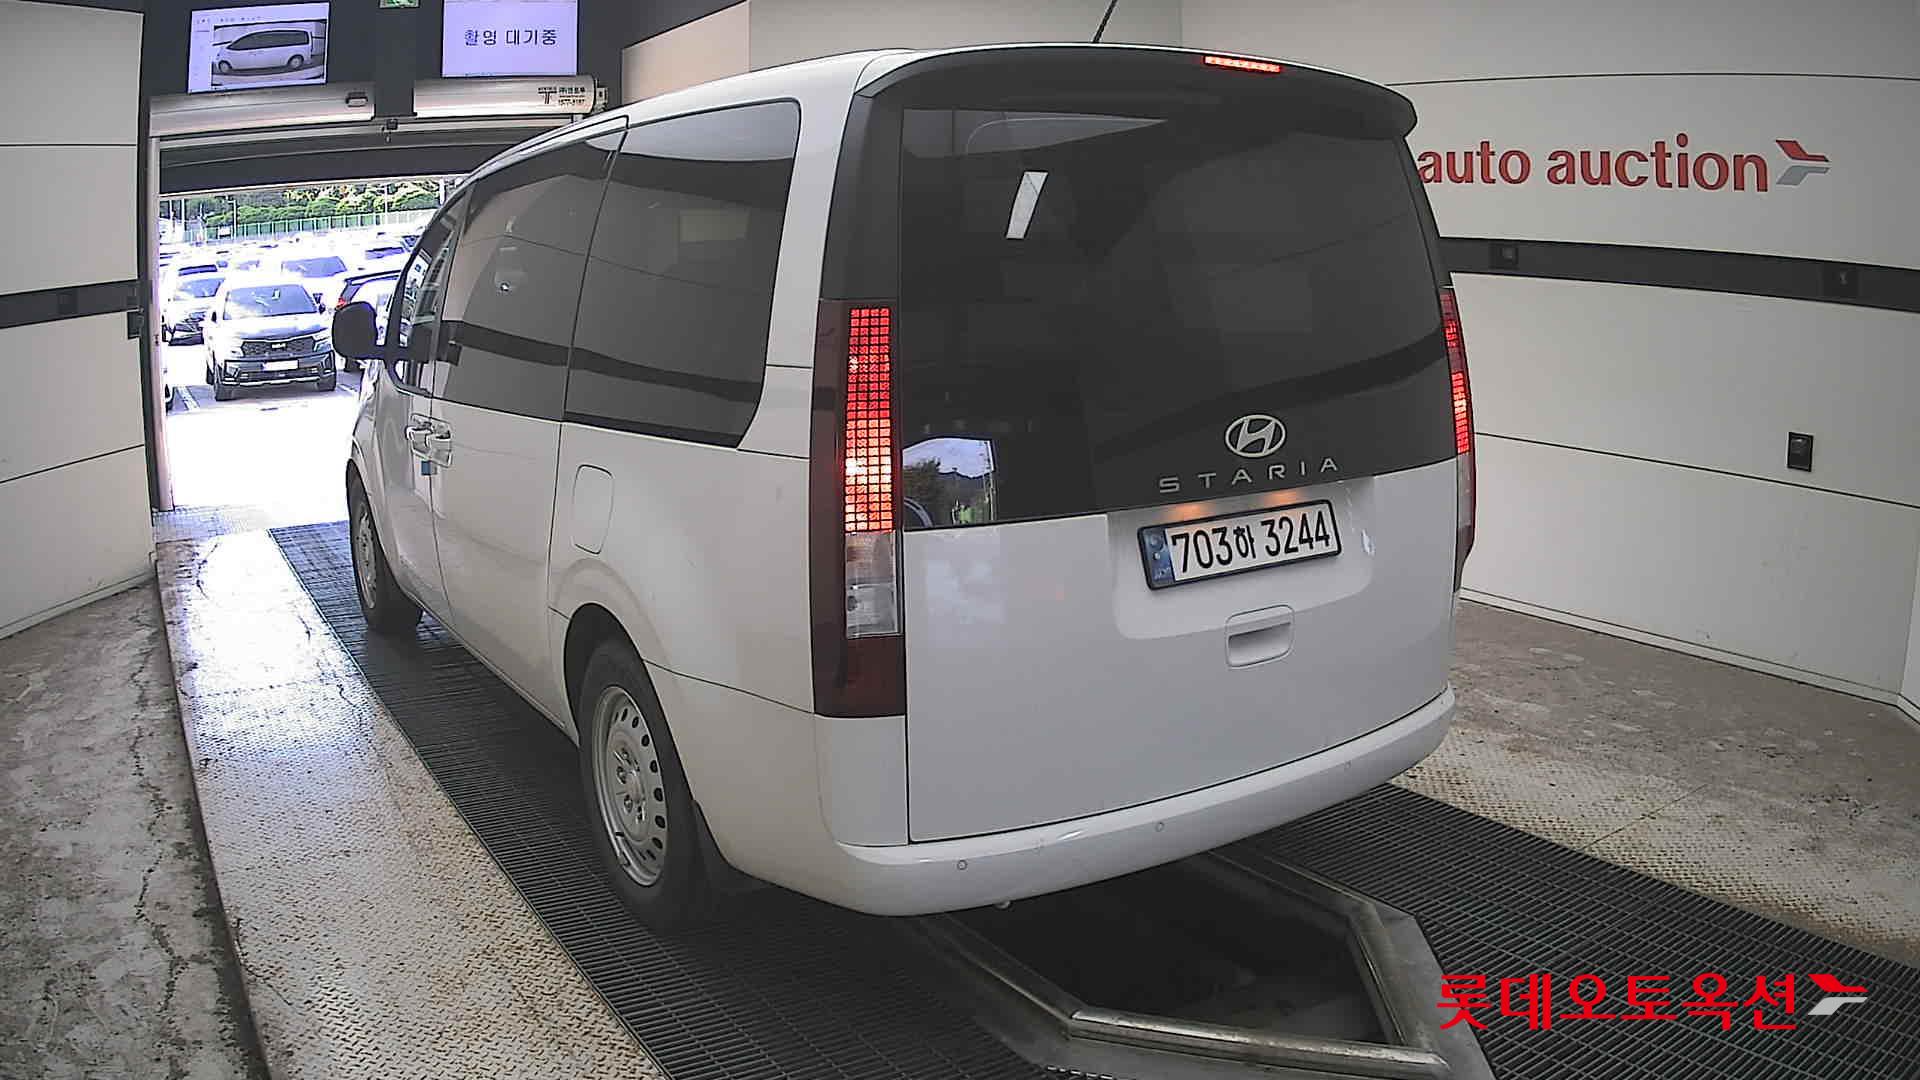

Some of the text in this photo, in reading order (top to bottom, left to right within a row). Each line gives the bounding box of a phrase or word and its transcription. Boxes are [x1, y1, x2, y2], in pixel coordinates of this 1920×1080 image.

[506, 29, 557, 46] 대기중
[1419, 133, 1769, 193] auto auction
[1159, 457, 1337, 493] STARIA
[1171, 511, 1330, 573] 703하 3244
